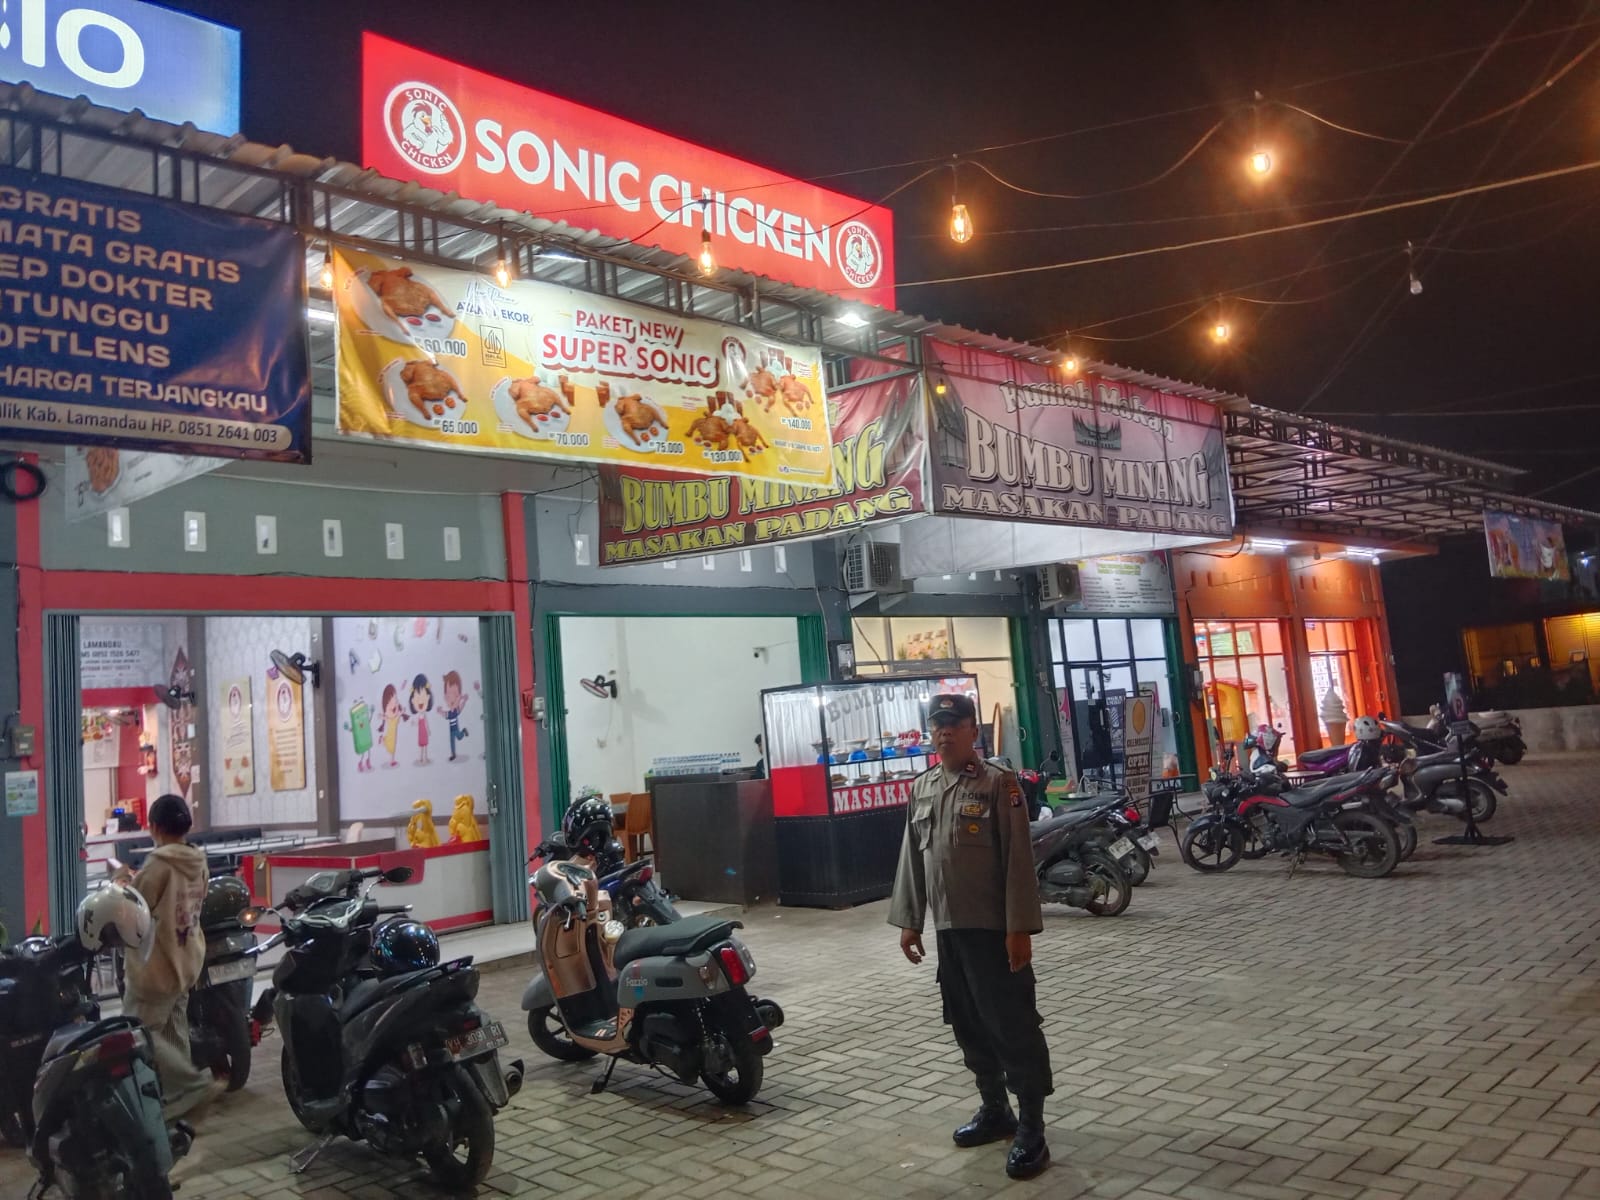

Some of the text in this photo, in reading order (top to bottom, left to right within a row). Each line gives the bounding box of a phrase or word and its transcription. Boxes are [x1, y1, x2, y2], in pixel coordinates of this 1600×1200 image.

[405, 89, 447, 111] SONIC
[401, 140, 453, 168] CHICKEN
[475, 118, 831, 268] SONIC CHICKEN
[847, 226, 870, 241] SONIC
[105, 241, 240, 283] GRATIS
[845, 266, 874, 283] CHICKEN
[61, 264, 214, 311] DOKTER
[0, 289, 169, 335] TUNGGU
[501, 309, 530, 324] EKOR
[576, 309, 678, 341] PAKET NEW
[424, 338, 466, 357] 60.000
[543, 333, 711, 378] SUPER SONIC
[100, 375, 267, 413] TERJANGKAU
[1000, 380, 1174, 443] Rumah Makan
[27, 405, 61, 424] Kab.
[67, 410, 147, 432] Lamandau
[151, 418, 174, 433] HP.
[178, 420, 212, 437] 0851
[217, 424, 250, 441] 2641
[253, 428, 277, 443] 003
[442, 419, 477, 434] 65.000
[556, 433, 588, 446] 70.000
[655, 441, 683, 454] 75.000
[964, 406, 1211, 508] BUMBU MINANG
[619, 475, 731, 534] BUMBU
[942, 484, 1108, 524] MASAKAN
[604, 487, 913, 562] MASAKAN PADANG
[826, 685, 895, 722] BUMBU
